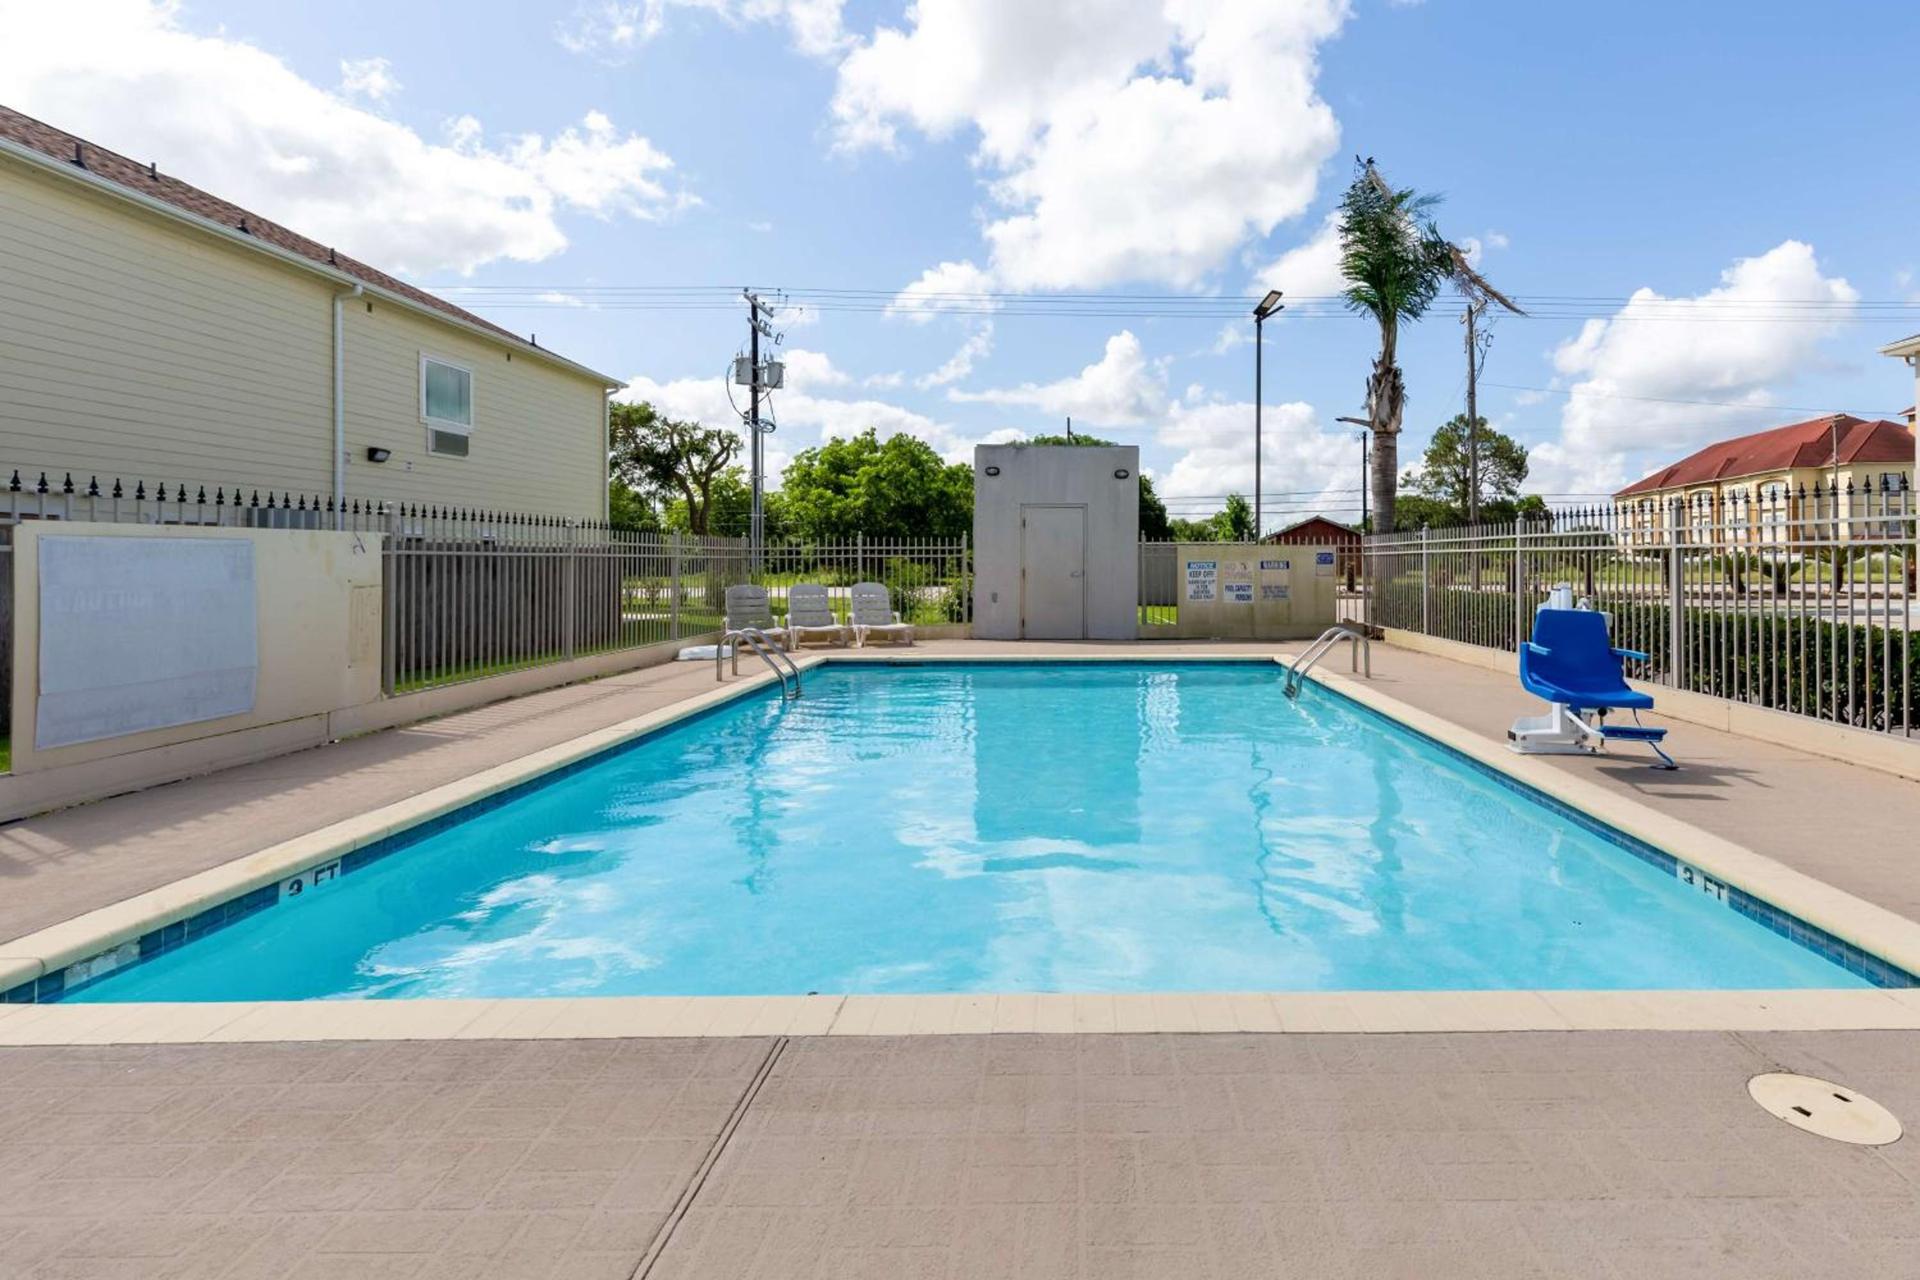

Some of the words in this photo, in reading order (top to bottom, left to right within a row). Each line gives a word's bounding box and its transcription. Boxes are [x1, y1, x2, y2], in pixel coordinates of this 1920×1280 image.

[288, 879, 303, 897] 3
[314, 862, 339, 887] FT
[1682, 866, 1695, 886] 3
[1703, 875, 1726, 901] FT
